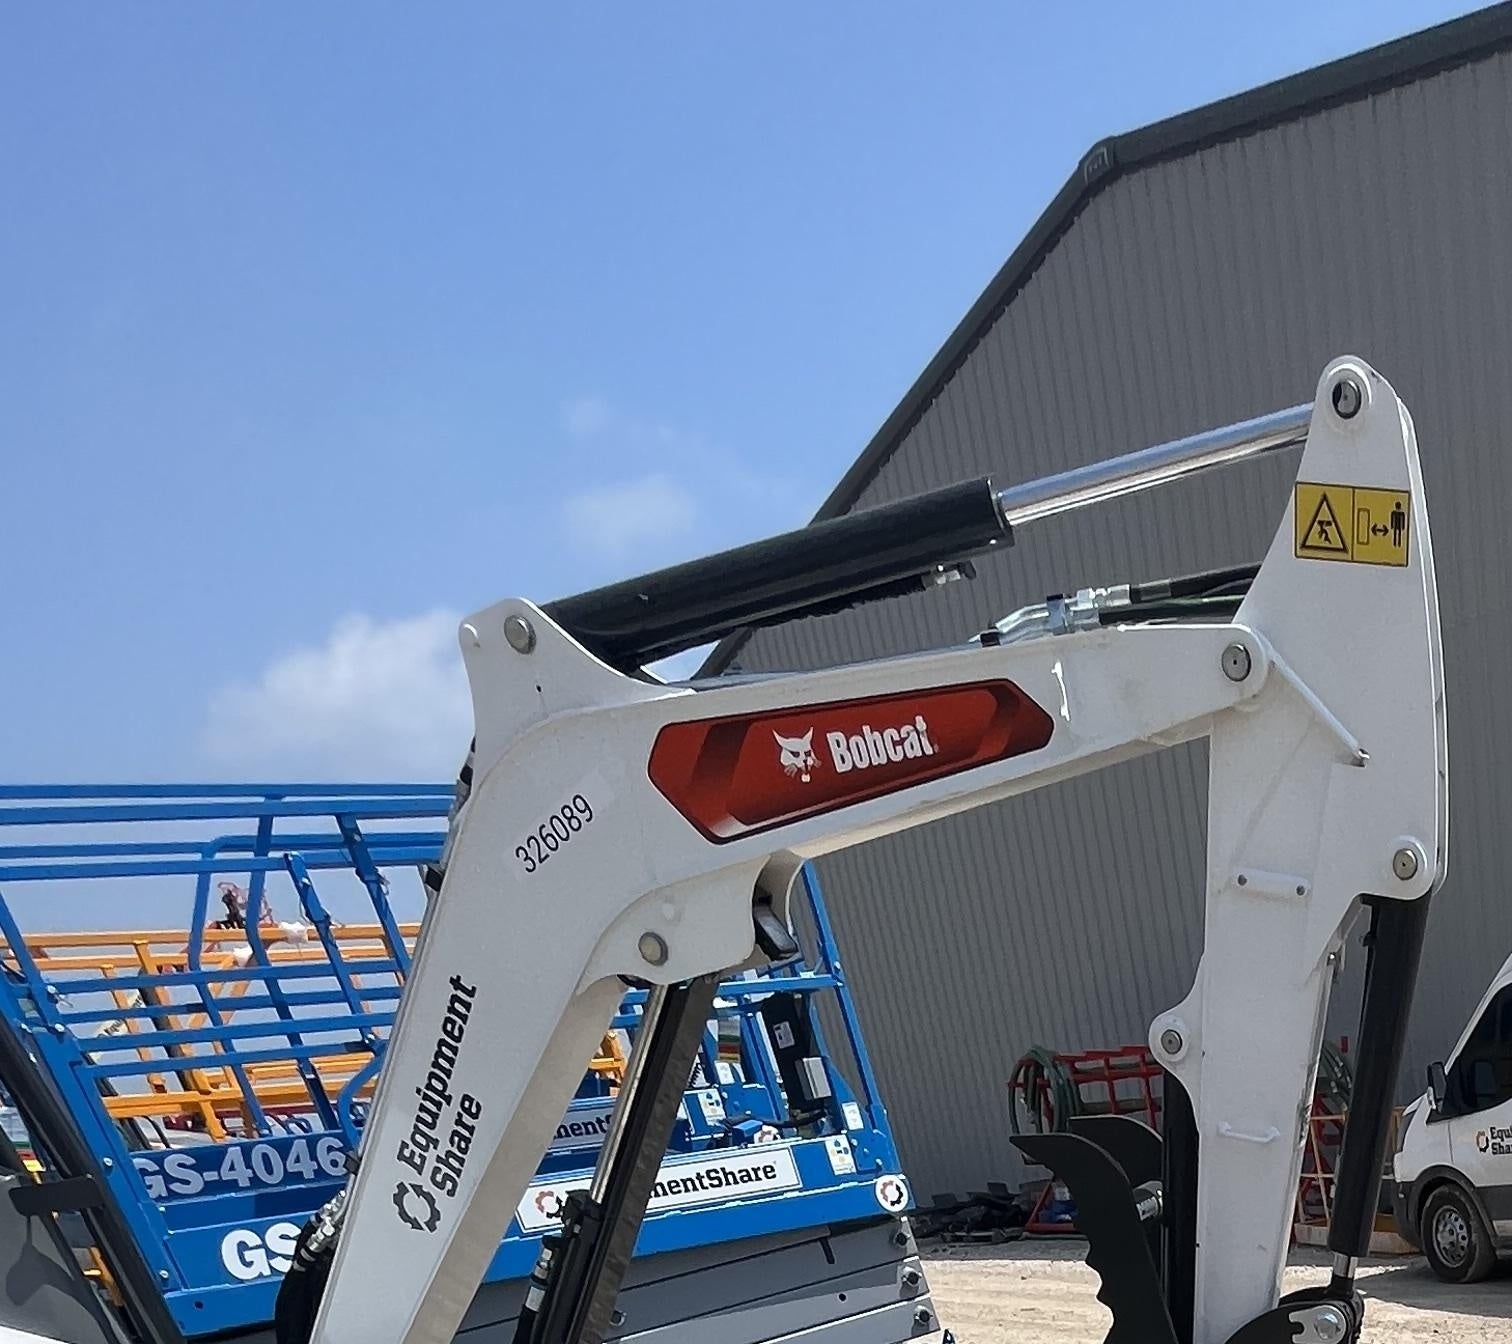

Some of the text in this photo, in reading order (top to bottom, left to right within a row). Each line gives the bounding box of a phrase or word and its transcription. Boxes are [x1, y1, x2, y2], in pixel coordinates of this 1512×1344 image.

[826, 715, 934, 774] Bobcat
[515, 794, 593, 873] 326089
[397, 974, 478, 1177] Equipment
[131, 1136, 347, 1199] GS-4046
[430, 1093, 483, 1198] Share
